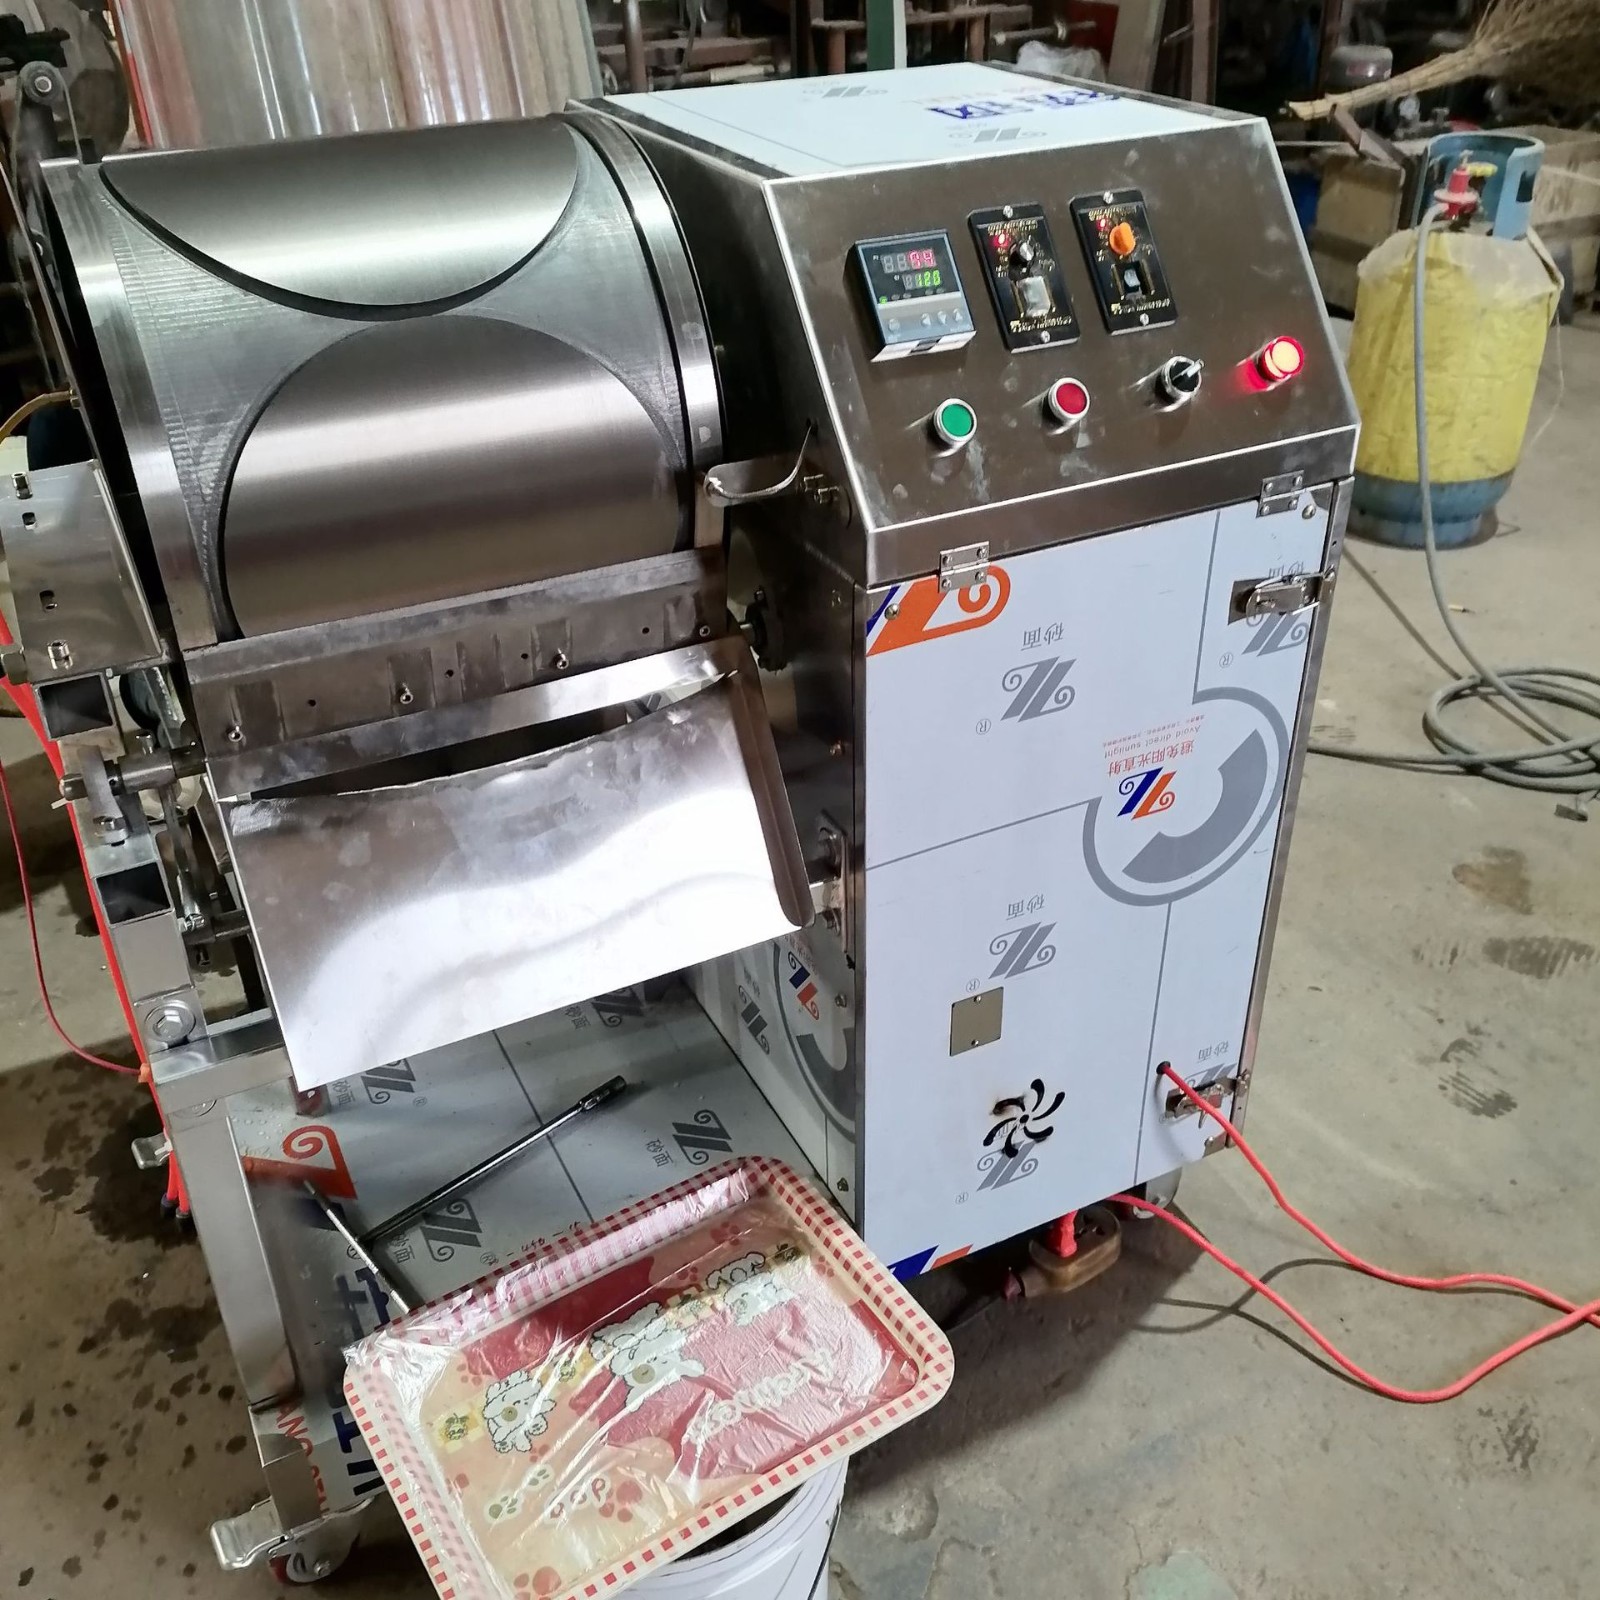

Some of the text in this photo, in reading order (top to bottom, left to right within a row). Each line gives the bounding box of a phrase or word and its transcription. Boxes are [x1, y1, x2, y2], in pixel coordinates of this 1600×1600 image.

[1020, 622, 1064, 651] 砂面
[1145, 733, 1172, 747] direct
[1175, 725, 1201, 737] Avoid
[1104, 741, 1141, 759] sunlight
[1108, 739, 1195, 778] 避免阳光直射
[1005, 894, 1045, 921] 砂面
[1197, 1041, 1230, 1062] 砂面
[332, 1079, 357, 1106] 砂面
[645, 1137, 674, 1168] 砂面
